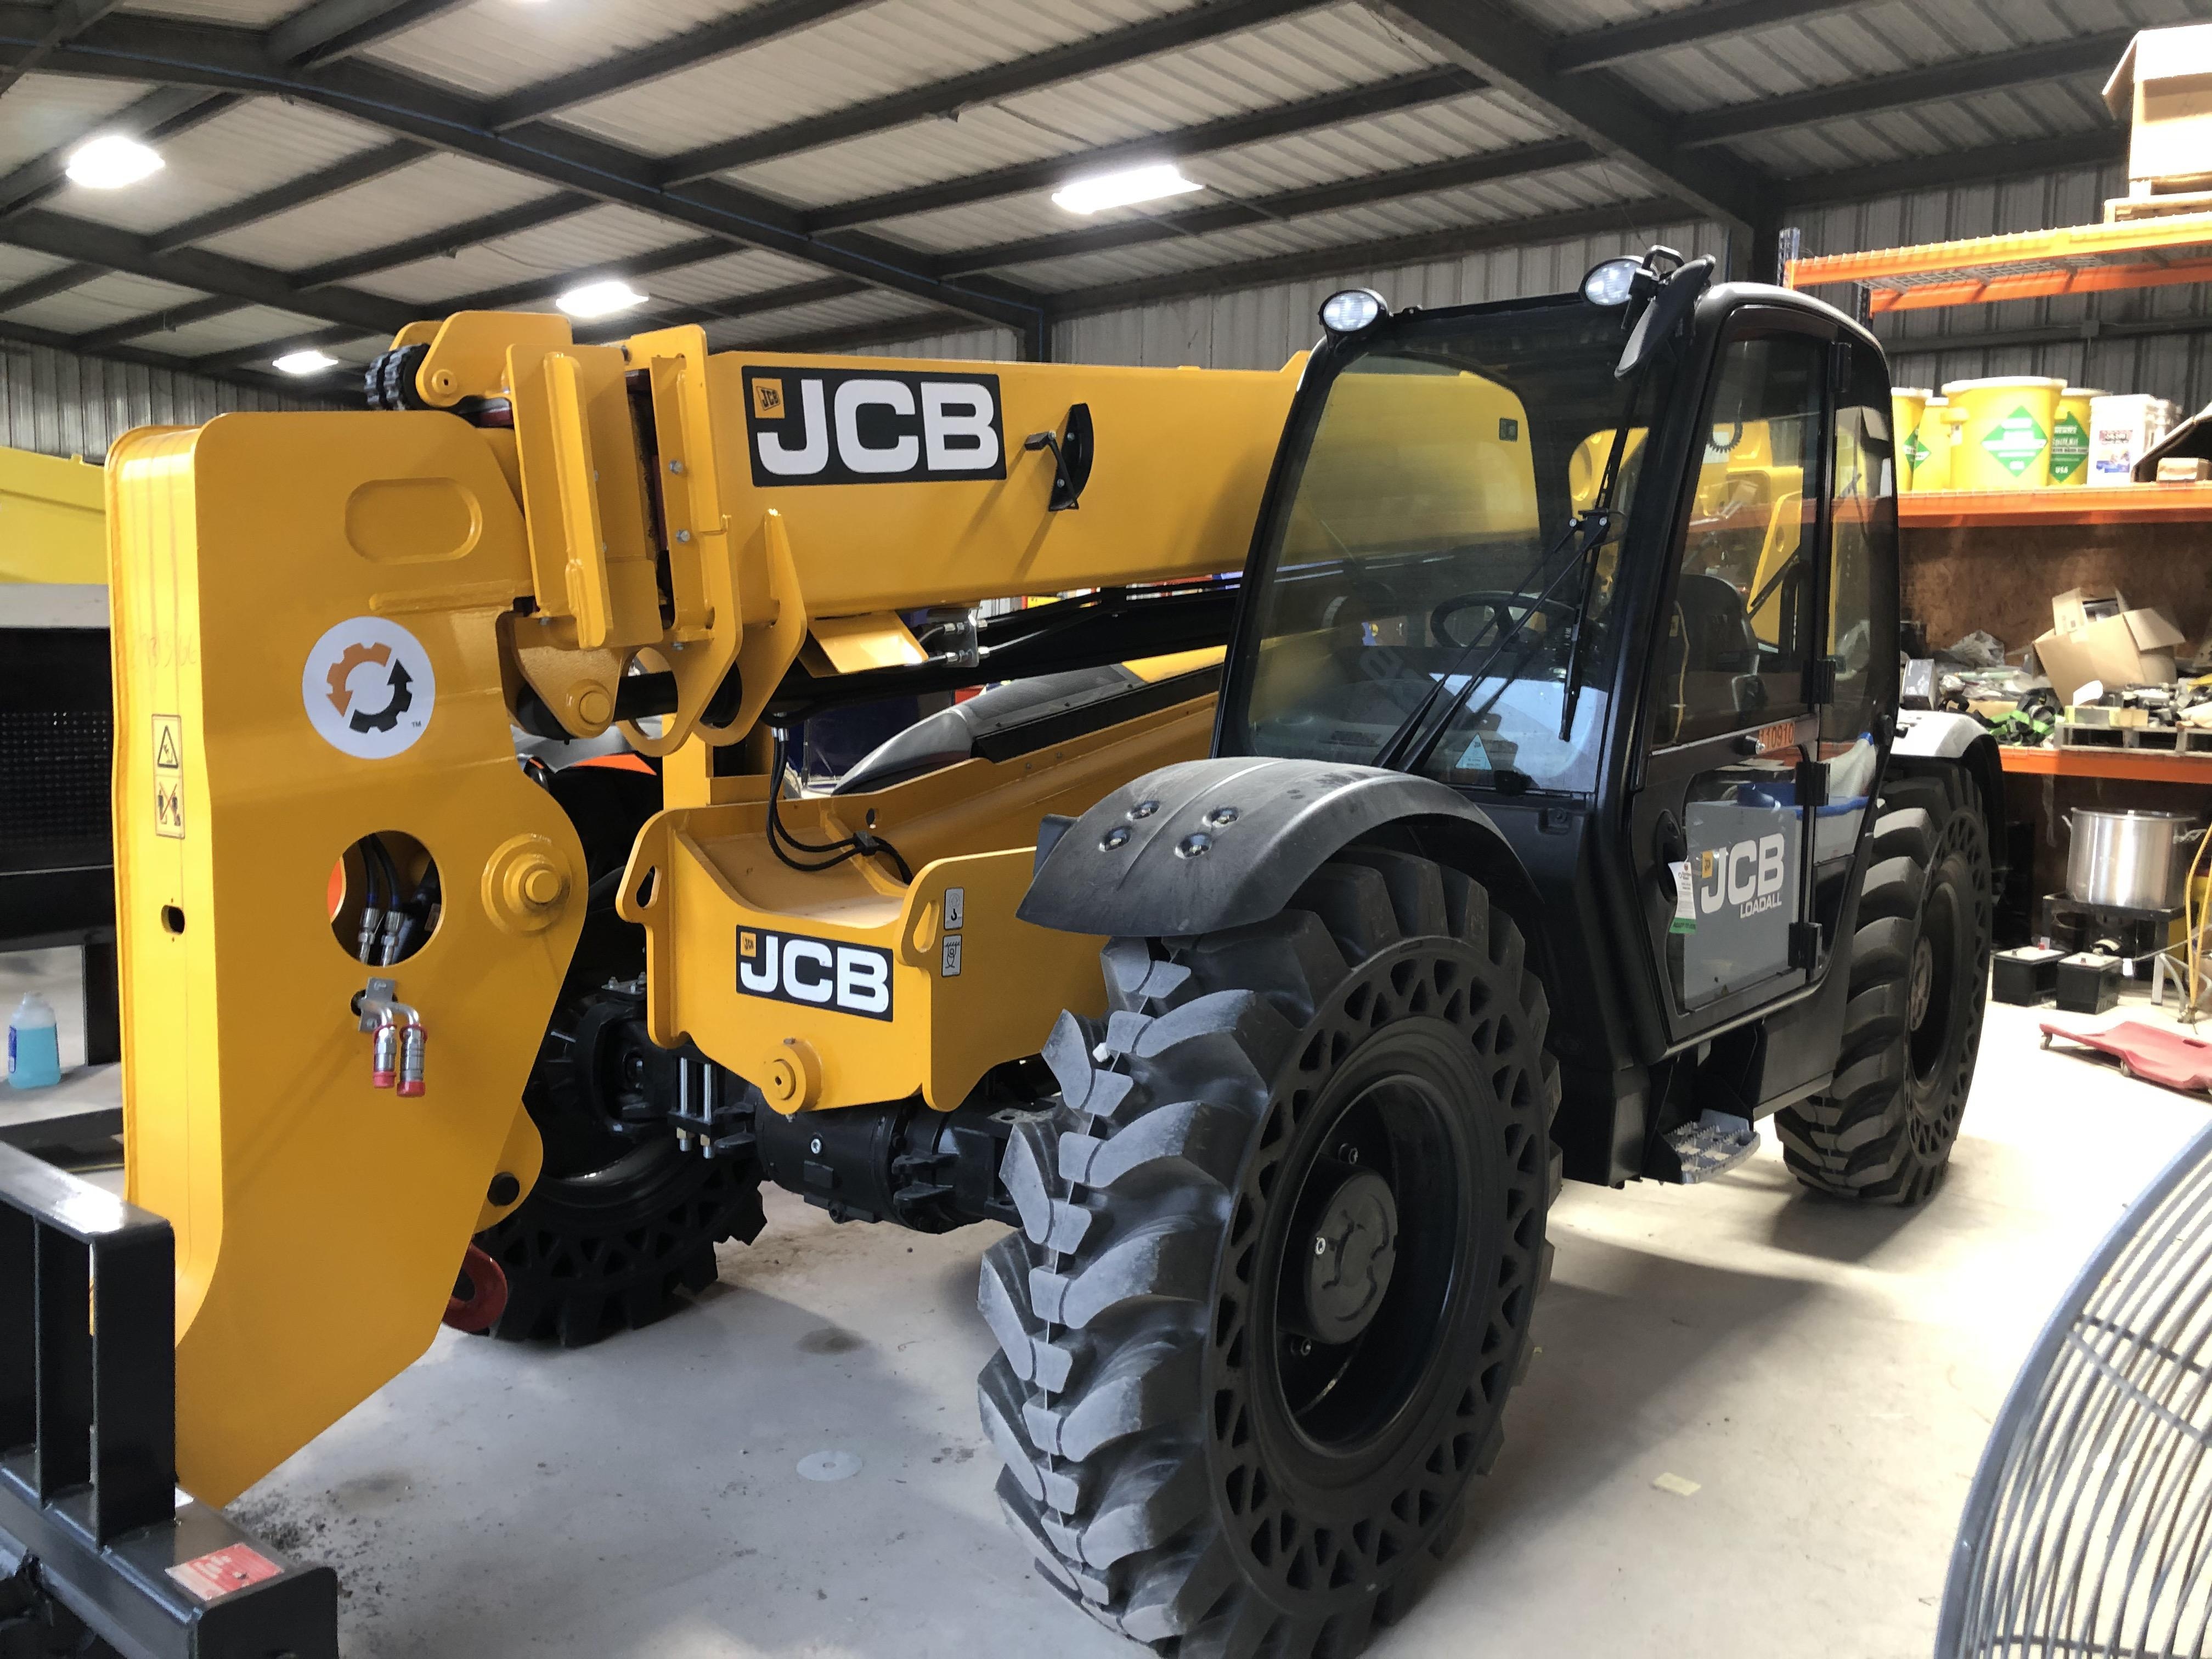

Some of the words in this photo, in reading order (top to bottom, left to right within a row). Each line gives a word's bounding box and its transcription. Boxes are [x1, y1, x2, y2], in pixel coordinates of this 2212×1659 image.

[757, 379, 999, 476] JCB
[761, 389, 779, 408] JCB
[1701, 833, 1784, 914] JCB
[1740, 893, 1782, 919] LOADALL
[740, 935, 889, 1013] JCB
